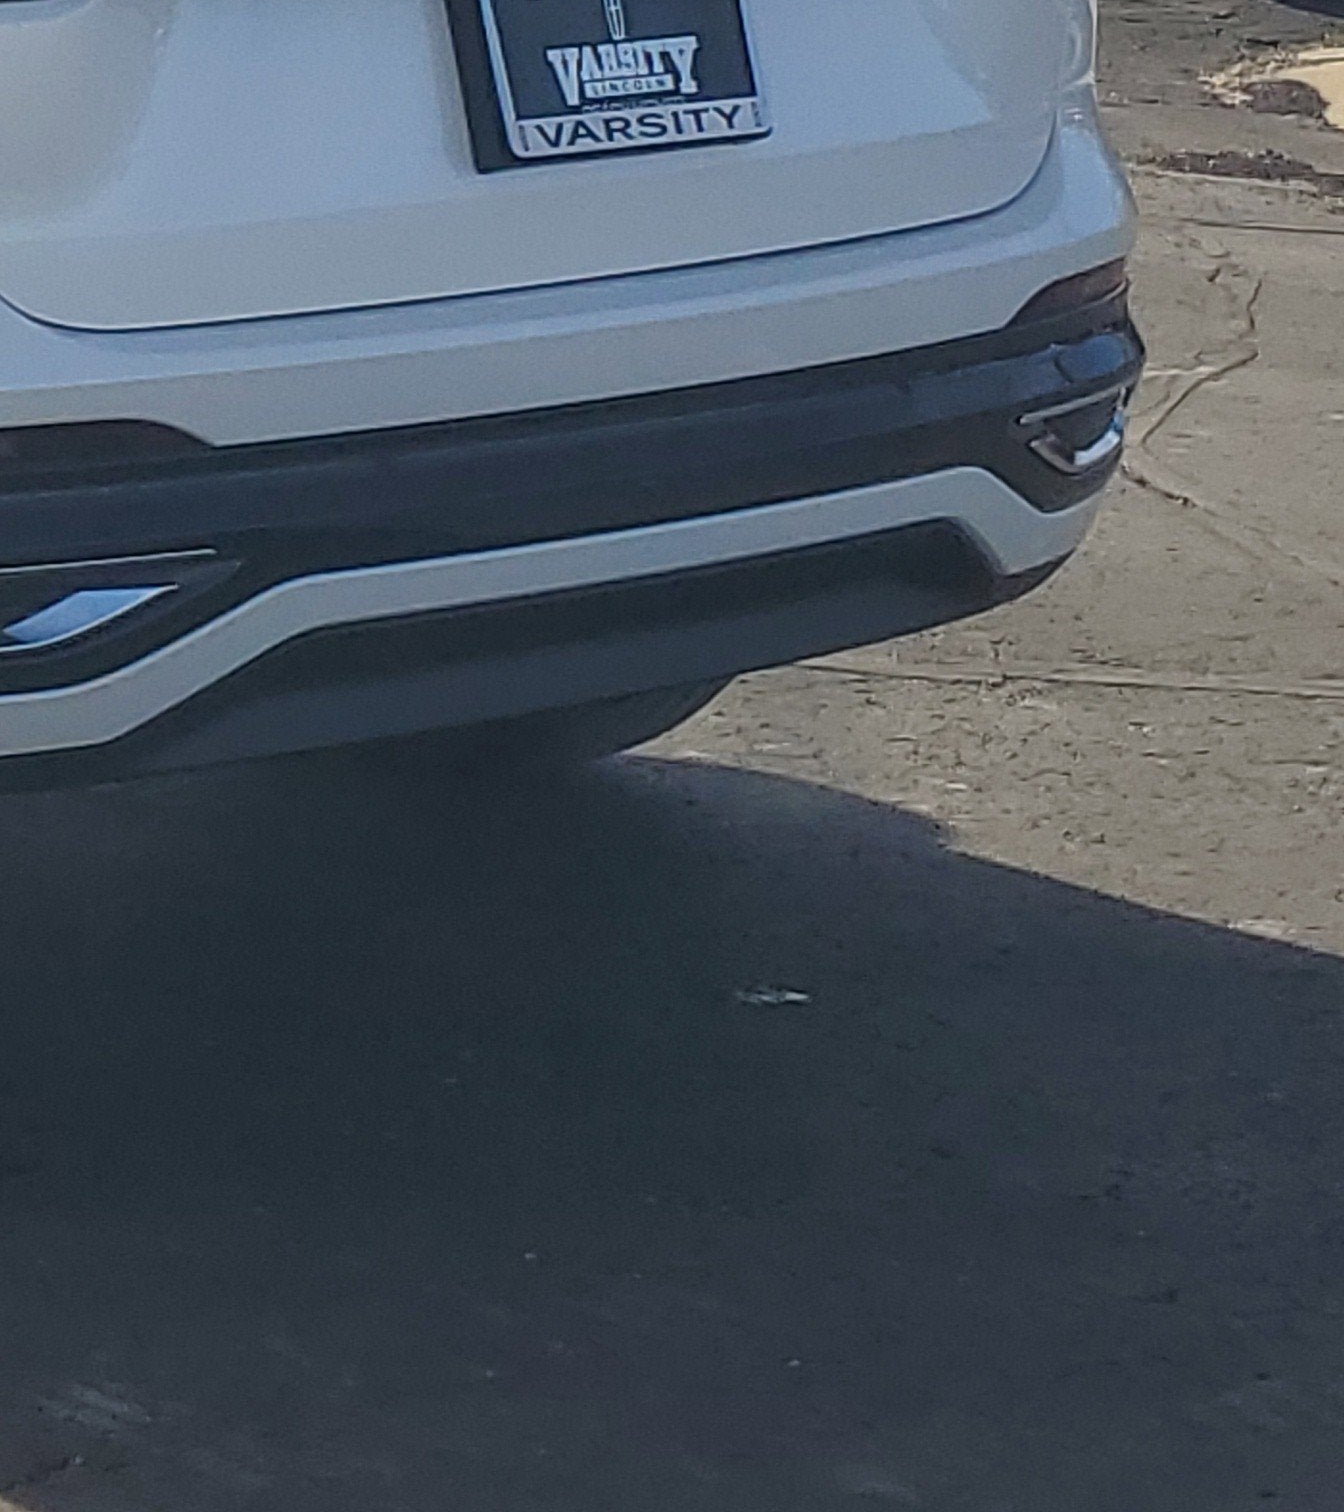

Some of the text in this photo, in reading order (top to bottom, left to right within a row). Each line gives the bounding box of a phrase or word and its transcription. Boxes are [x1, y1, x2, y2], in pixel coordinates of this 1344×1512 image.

[545, 35, 700, 107] VARSITY
[591, 78, 667, 96] LINCOLN
[534, 103, 741, 150] VARSITY
